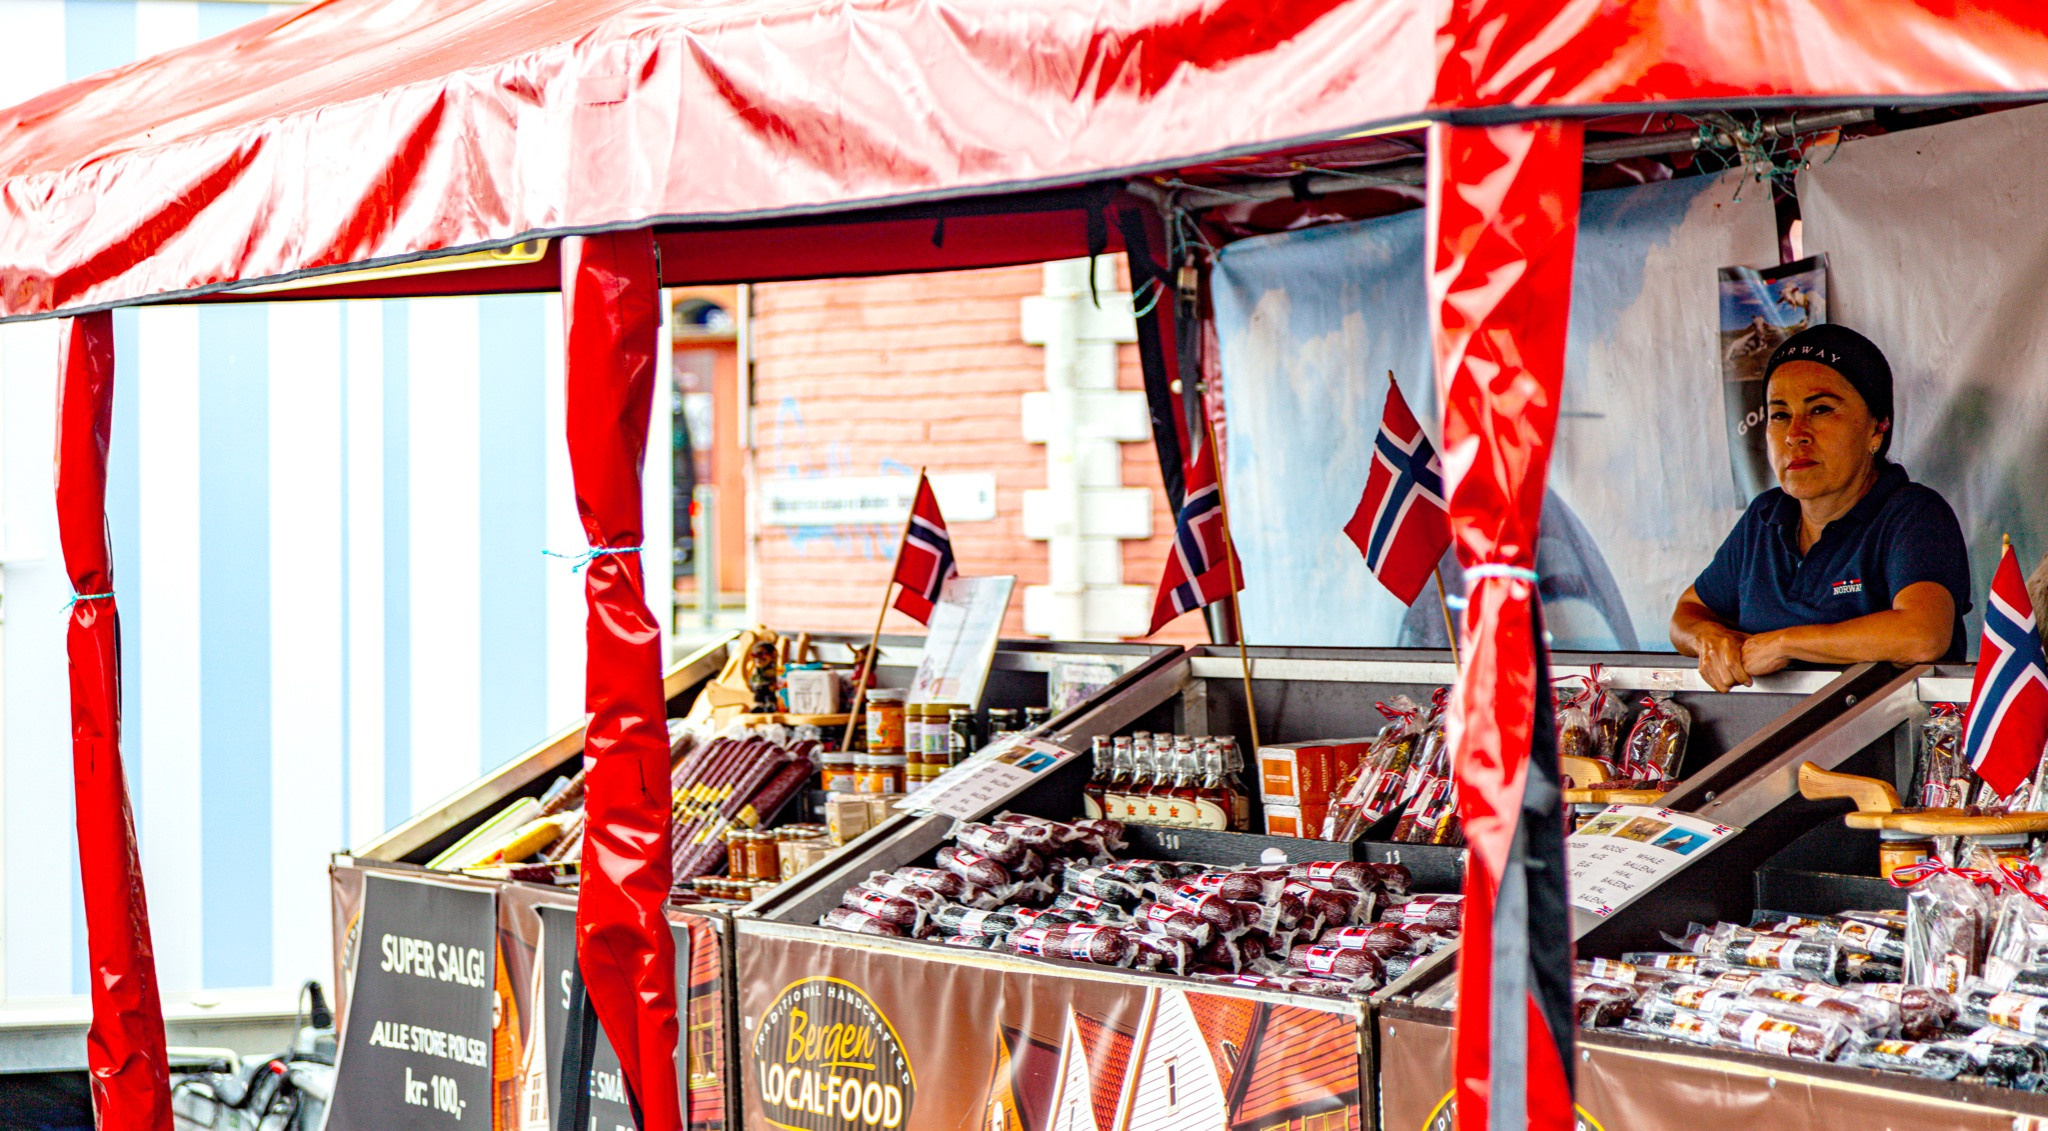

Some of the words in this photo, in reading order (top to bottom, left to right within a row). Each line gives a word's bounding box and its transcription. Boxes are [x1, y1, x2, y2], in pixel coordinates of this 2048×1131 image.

[1771, 345, 1841, 363] RWAY
[1600, 844, 1628, 854] MOOSE
[1636, 852, 1665, 866] WHALE
[1613, 869, 1633, 880] HVAL
[1623, 861, 1657, 875] BALLENA
[1589, 884, 1607, 895] WAL
[1600, 876, 1636, 892] BALEINE
[1577, 893, 1607, 905] BALENA
[380, 933, 436, 979] SUPER
[437, 942, 485, 989] SALG!
[369, 1020, 410, 1050] ALLE
[410, 1025, 448, 1058] STORE
[448, 1033, 488, 1068] PØLSER
[755, 985, 822, 1056] TRADITIONAL
[827, 986, 910, 1085] HANDCRAFTED
[785, 1006, 877, 1076] Bergen
[404, 1066, 429, 1107] kr.
[430, 1074, 467, 1121] 100,-
